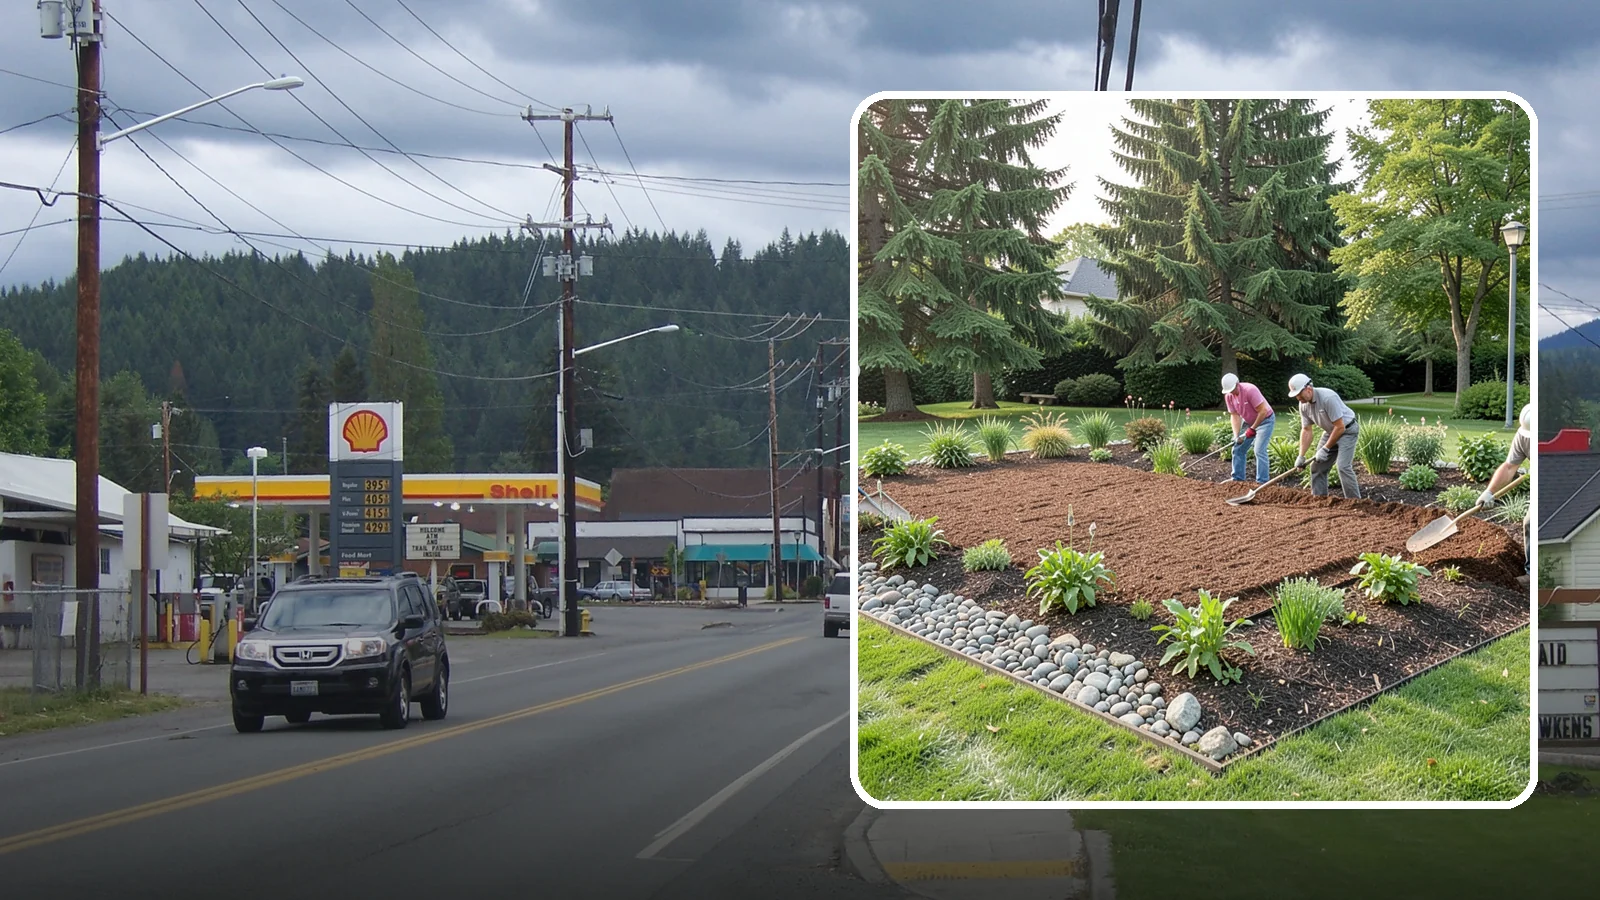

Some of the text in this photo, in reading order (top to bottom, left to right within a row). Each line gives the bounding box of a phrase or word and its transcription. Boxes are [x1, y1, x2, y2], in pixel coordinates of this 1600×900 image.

[366, 480, 383, 490] 395
[491, 485, 546, 498] Shell
[366, 494, 383, 504] 405
[366, 508, 383, 518] 415
[366, 522, 383, 532] 429
